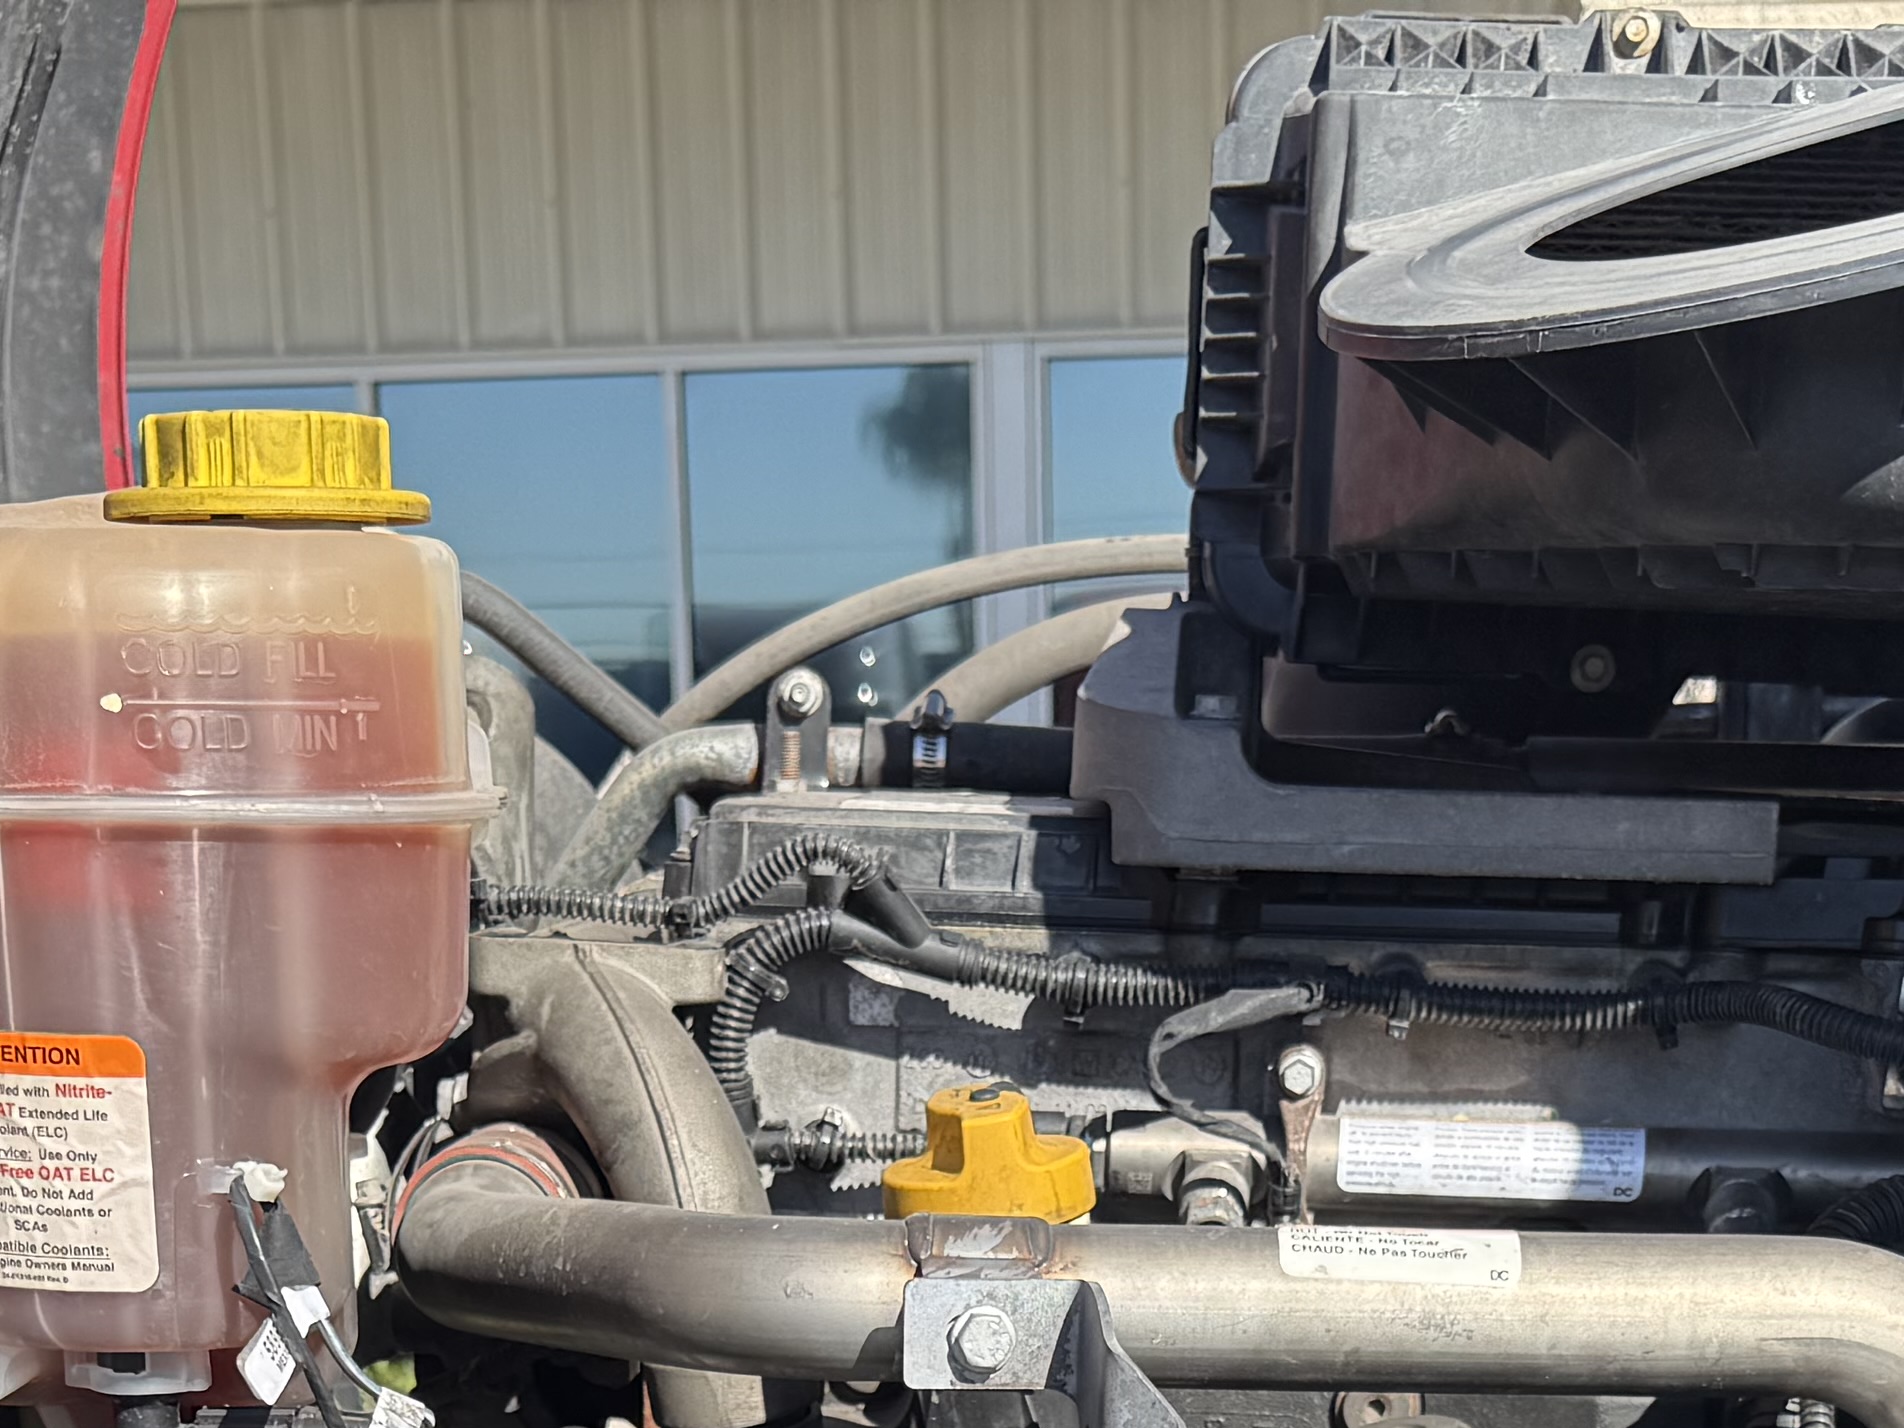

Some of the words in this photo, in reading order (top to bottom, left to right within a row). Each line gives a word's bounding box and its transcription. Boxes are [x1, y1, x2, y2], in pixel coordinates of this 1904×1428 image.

[122, 638, 240, 677] COLD
[266, 640, 336, 682] FILL
[135, 712, 248, 750] COLD
[22, 1086, 49, 1098] with
[55, 1084, 112, 1099] Nitrite-
[18, 1107, 78, 1120] Extended
[84, 1109, 108, 1122] Life
[32, 1124, 68, 1140] (ELC)
[38, 1148, 62, 1160] Use
[67, 1150, 97, 1164] Only
[38, 1166, 73, 1182] OAT
[80, 1168, 115, 1182] ELC
[22, 1187, 38, 1198] Do
[42, 1188, 63, 1200] Not
[68, 1190, 94, 1201] Add
[1614, 1187, 1632, 1197] DC
[36, 1204, 94, 1218] Coolants
[98, 1208, 112, 1218] or
[14, 1220, 48, 1232] SCAs
[41, 1242, 110, 1257] Coolants:
[1402, 1239, 1440, 1247] Tocar
[1291, 1244, 1344, 1256] CHAUD
[1382, 1248, 1407, 1258] Pas
[26, 1258, 66, 1271] Owners
[72, 1260, 114, 1272] Manual
[1490, 1270, 1509, 1281] DC
